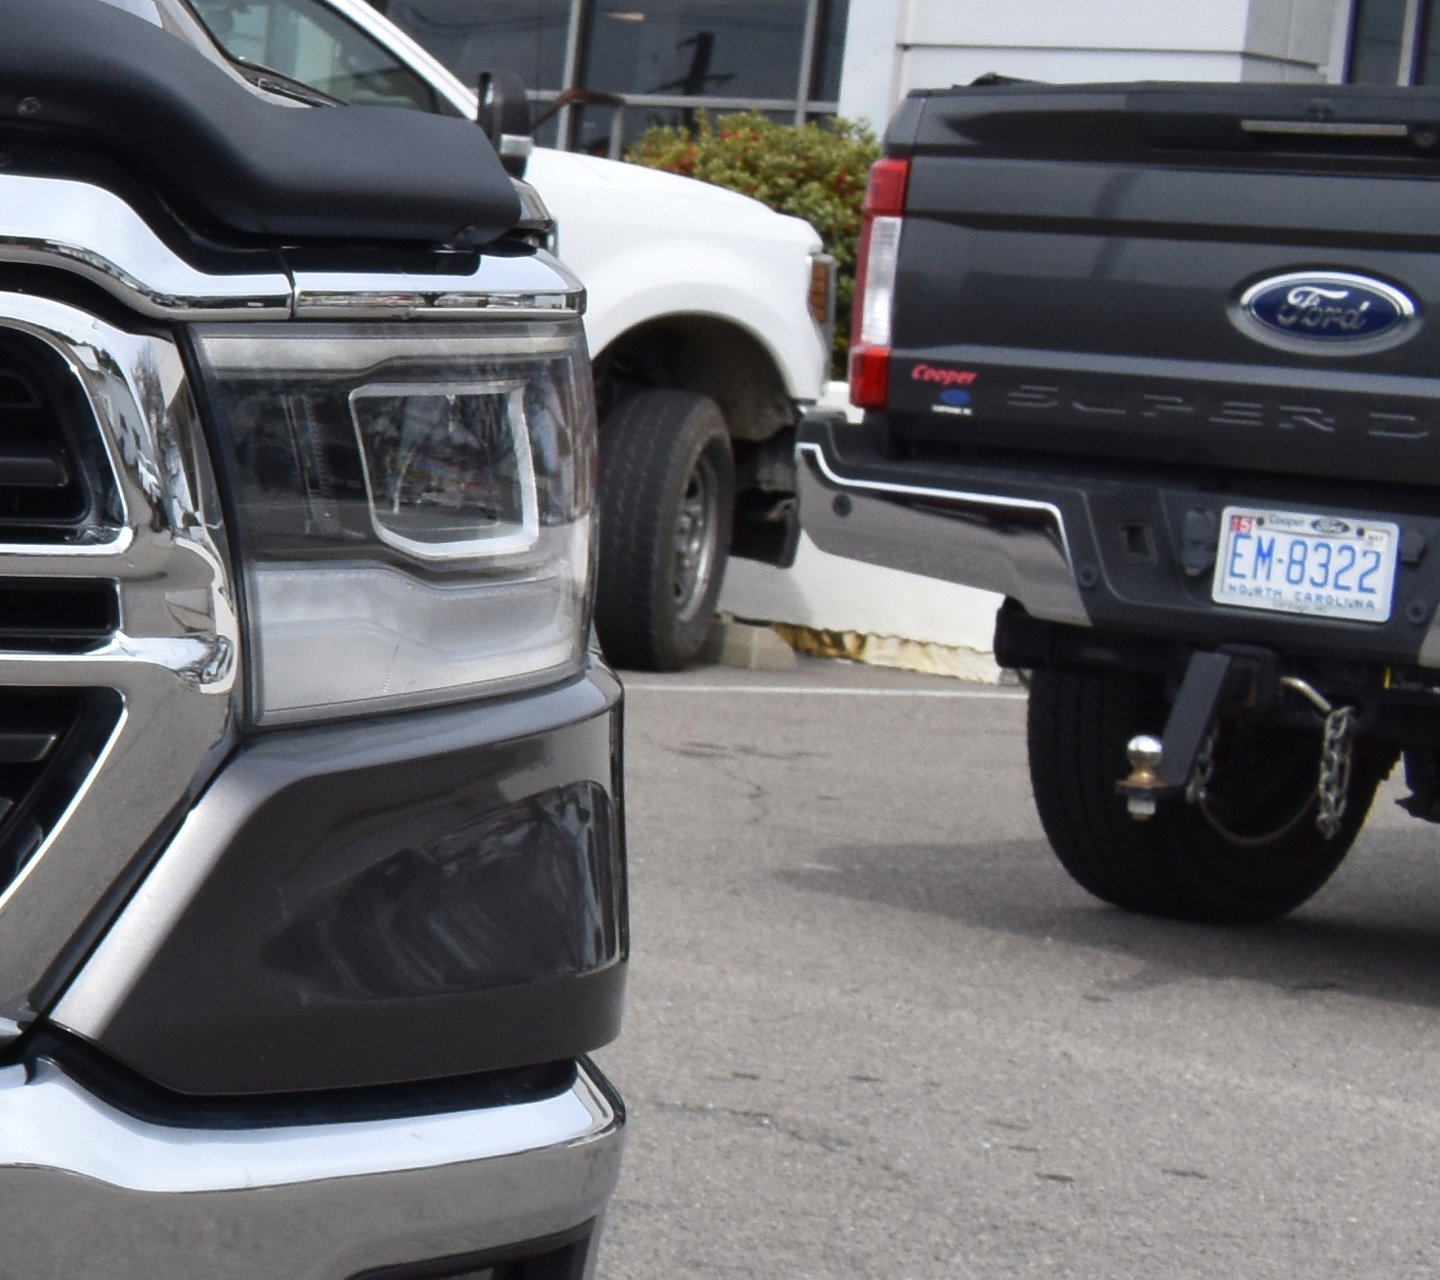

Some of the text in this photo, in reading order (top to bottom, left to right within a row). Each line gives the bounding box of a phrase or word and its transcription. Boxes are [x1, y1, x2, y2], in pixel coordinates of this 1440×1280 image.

[1277, 286, 1370, 330] Ford
[911, 363, 977, 387] Cooper
[1007, 384, 1336, 433] SUPER
[1228, 533, 1382, 595] EM-8322
[1229, 584, 1282, 598] NORTH
[1294, 590, 1376, 610] CAROLINA
